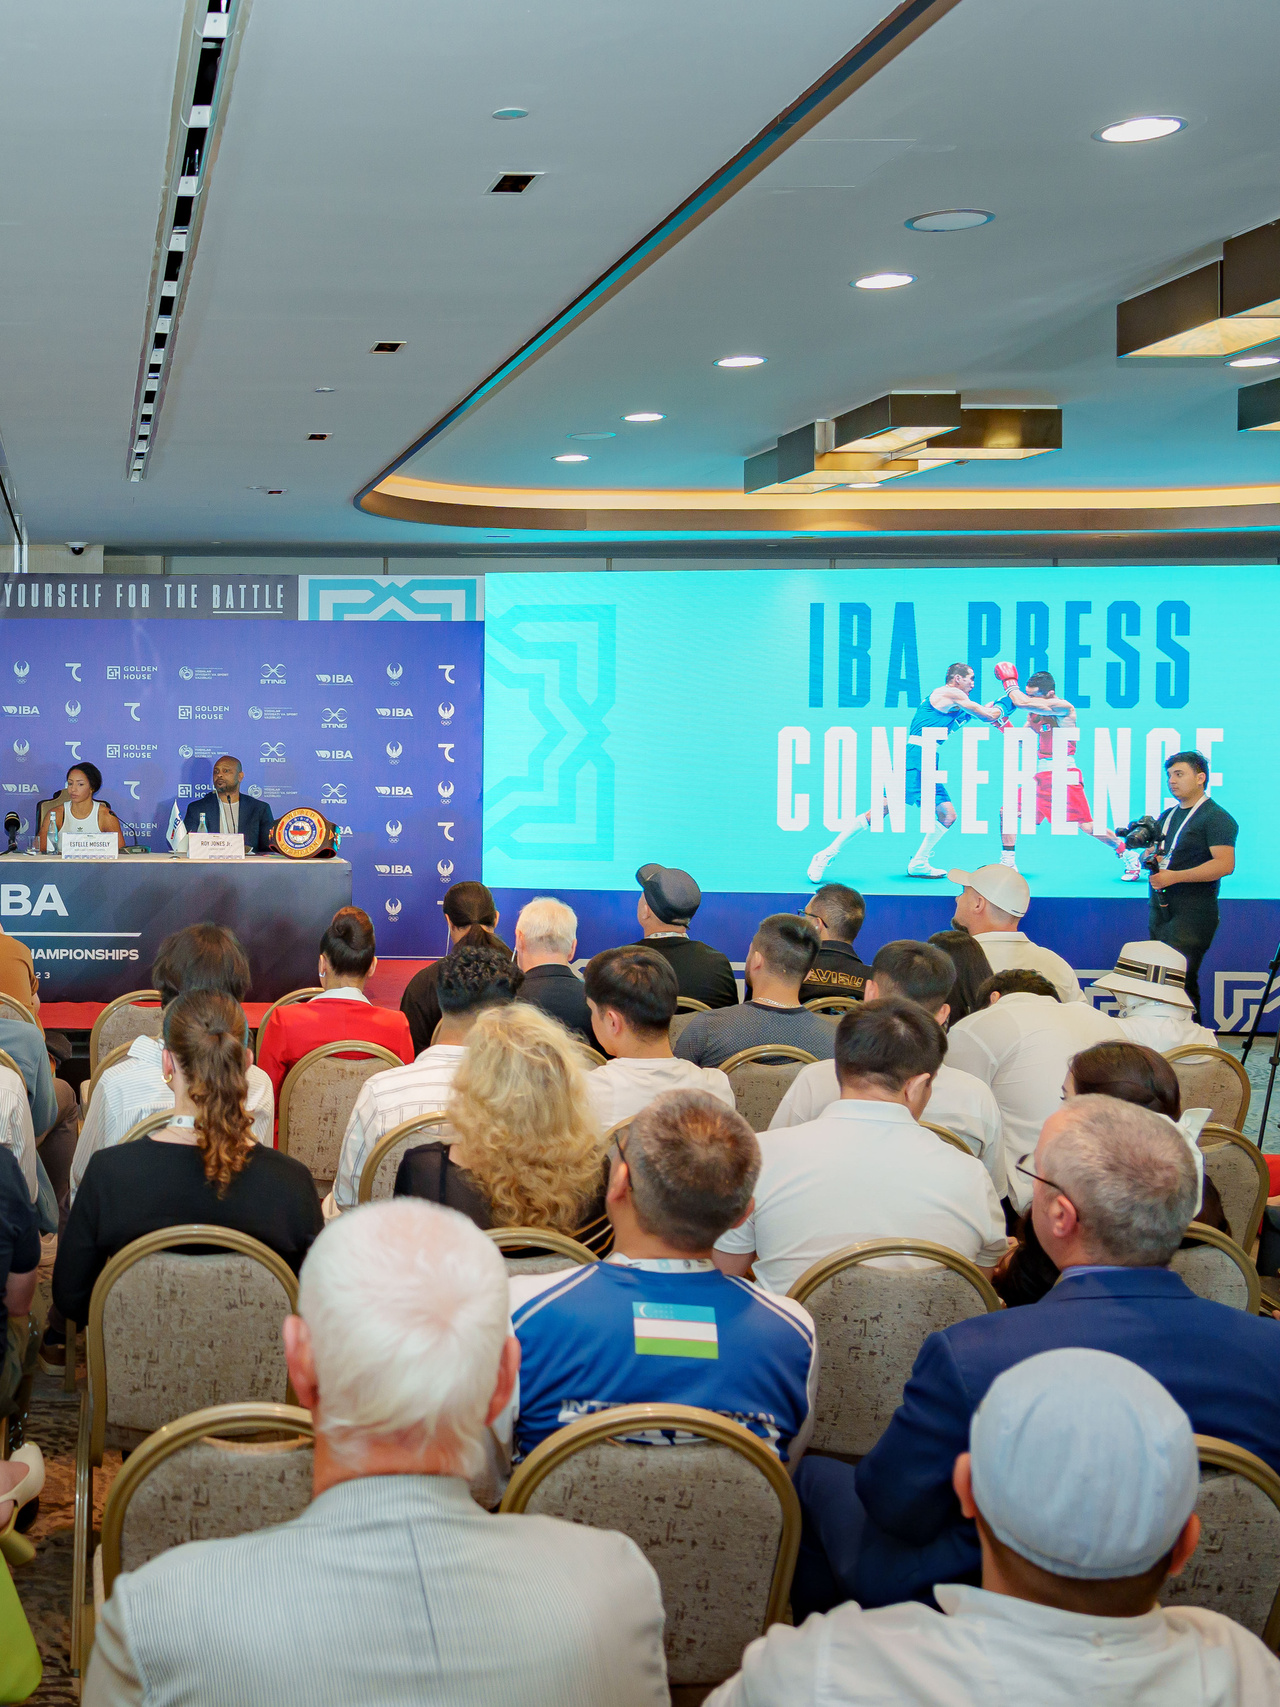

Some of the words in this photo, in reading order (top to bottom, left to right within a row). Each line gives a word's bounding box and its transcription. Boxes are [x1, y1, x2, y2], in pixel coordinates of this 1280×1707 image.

[4, 583, 102, 608] YOURSELF
[117, 584, 150, 608] FOR
[165, 584, 199, 609] THE
[213, 584, 284, 609] BATTLE
[809, 602, 919, 708] IBA
[968, 600, 1190, 709] PRESS
[332, 675, 353, 683] IBA
[18, 706, 40, 715] IBA
[392, 708, 413, 717] IBA
[332, 750, 353, 759] IBA
[18, 784, 40, 793] IBA
[391, 787, 413, 796] IBA
[391, 865, 413, 874] IBA
